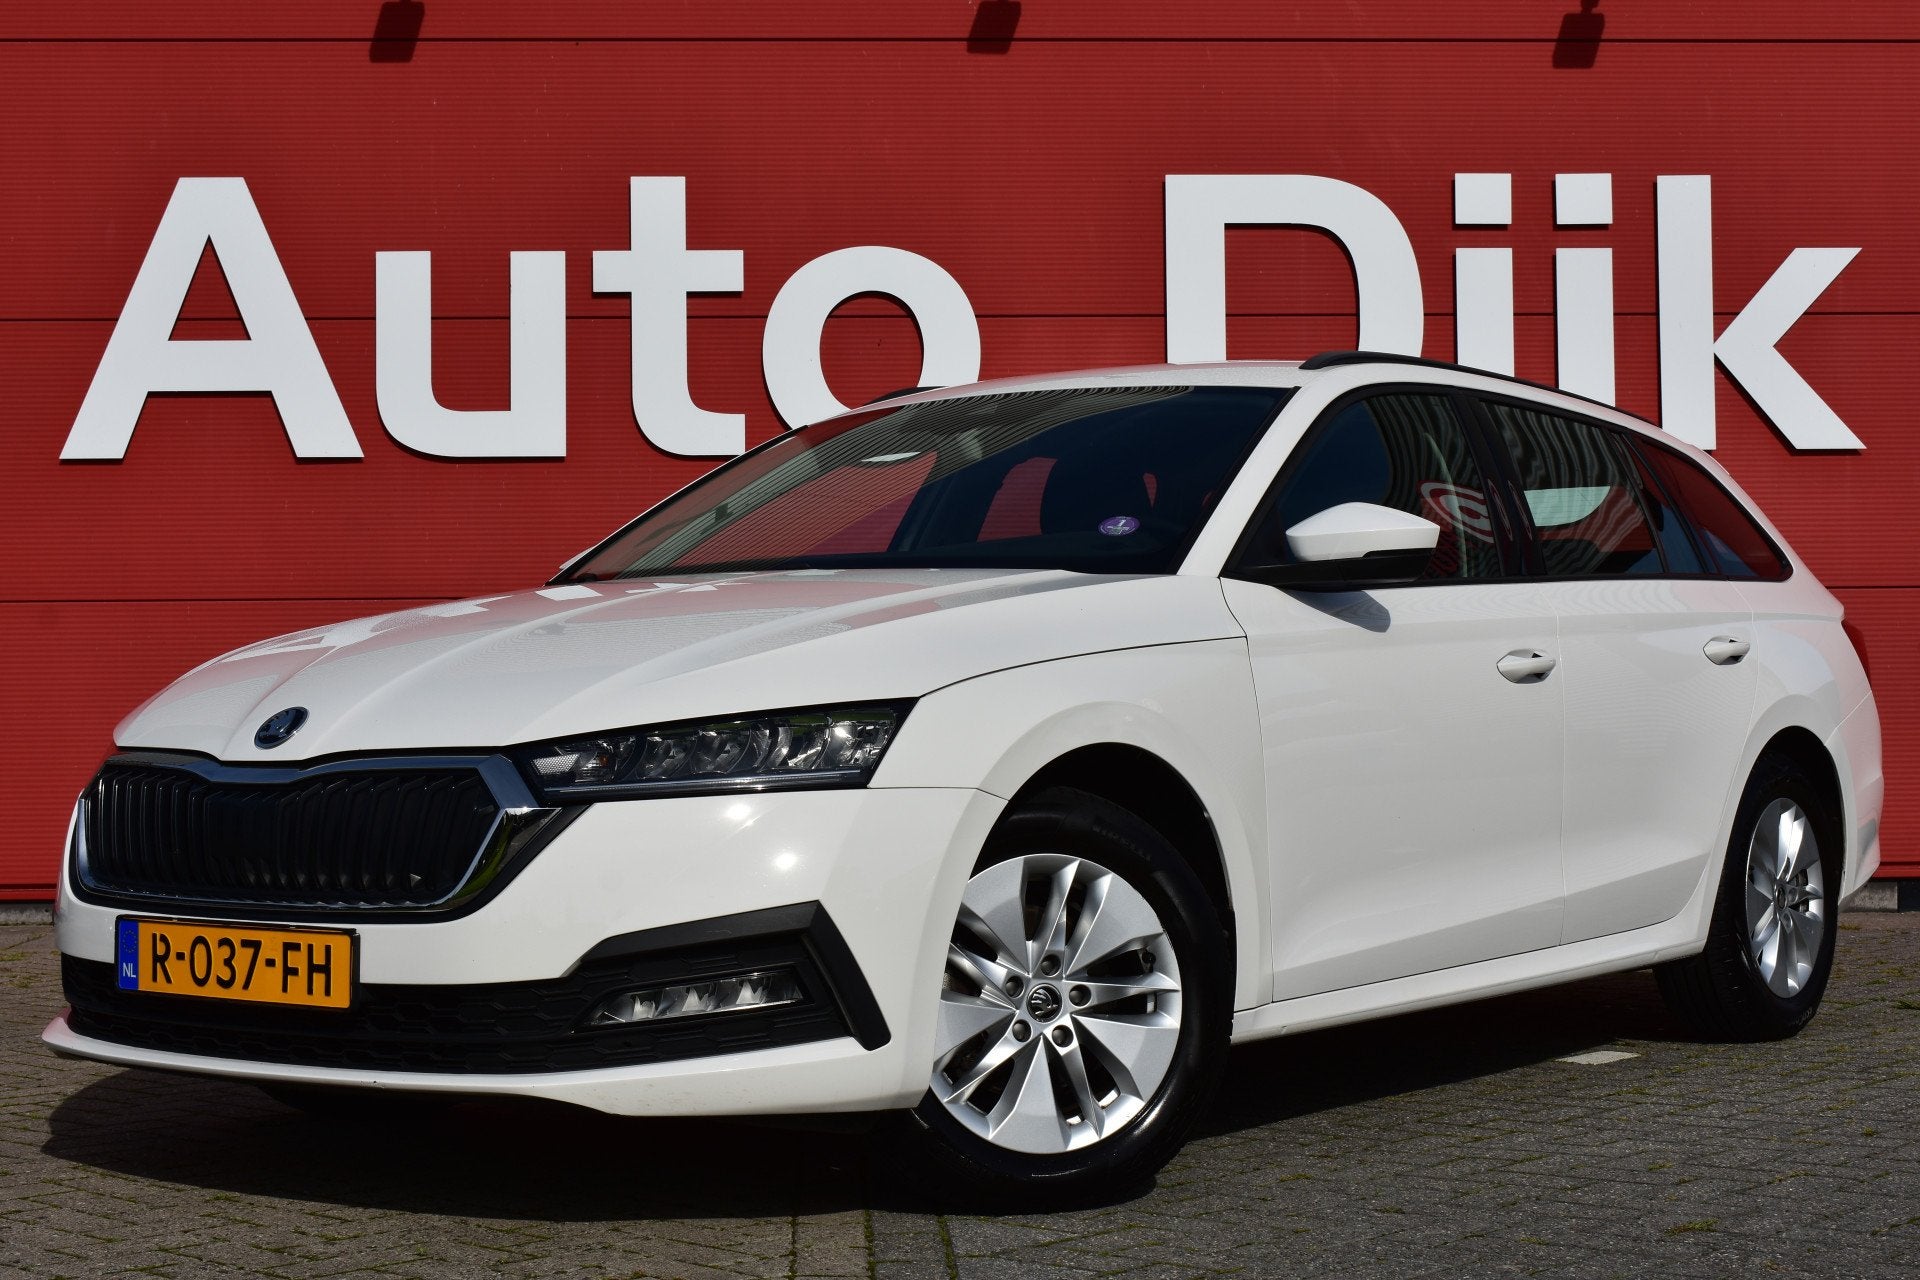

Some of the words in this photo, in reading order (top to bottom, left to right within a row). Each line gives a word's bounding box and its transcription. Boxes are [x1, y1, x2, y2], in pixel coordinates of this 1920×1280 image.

[60, 176, 981, 460] Auto
[1165, 173, 1867, 450] Dijk
[122, 962, 137, 978] NL
[151, 932, 333, 997] R-037-FH
